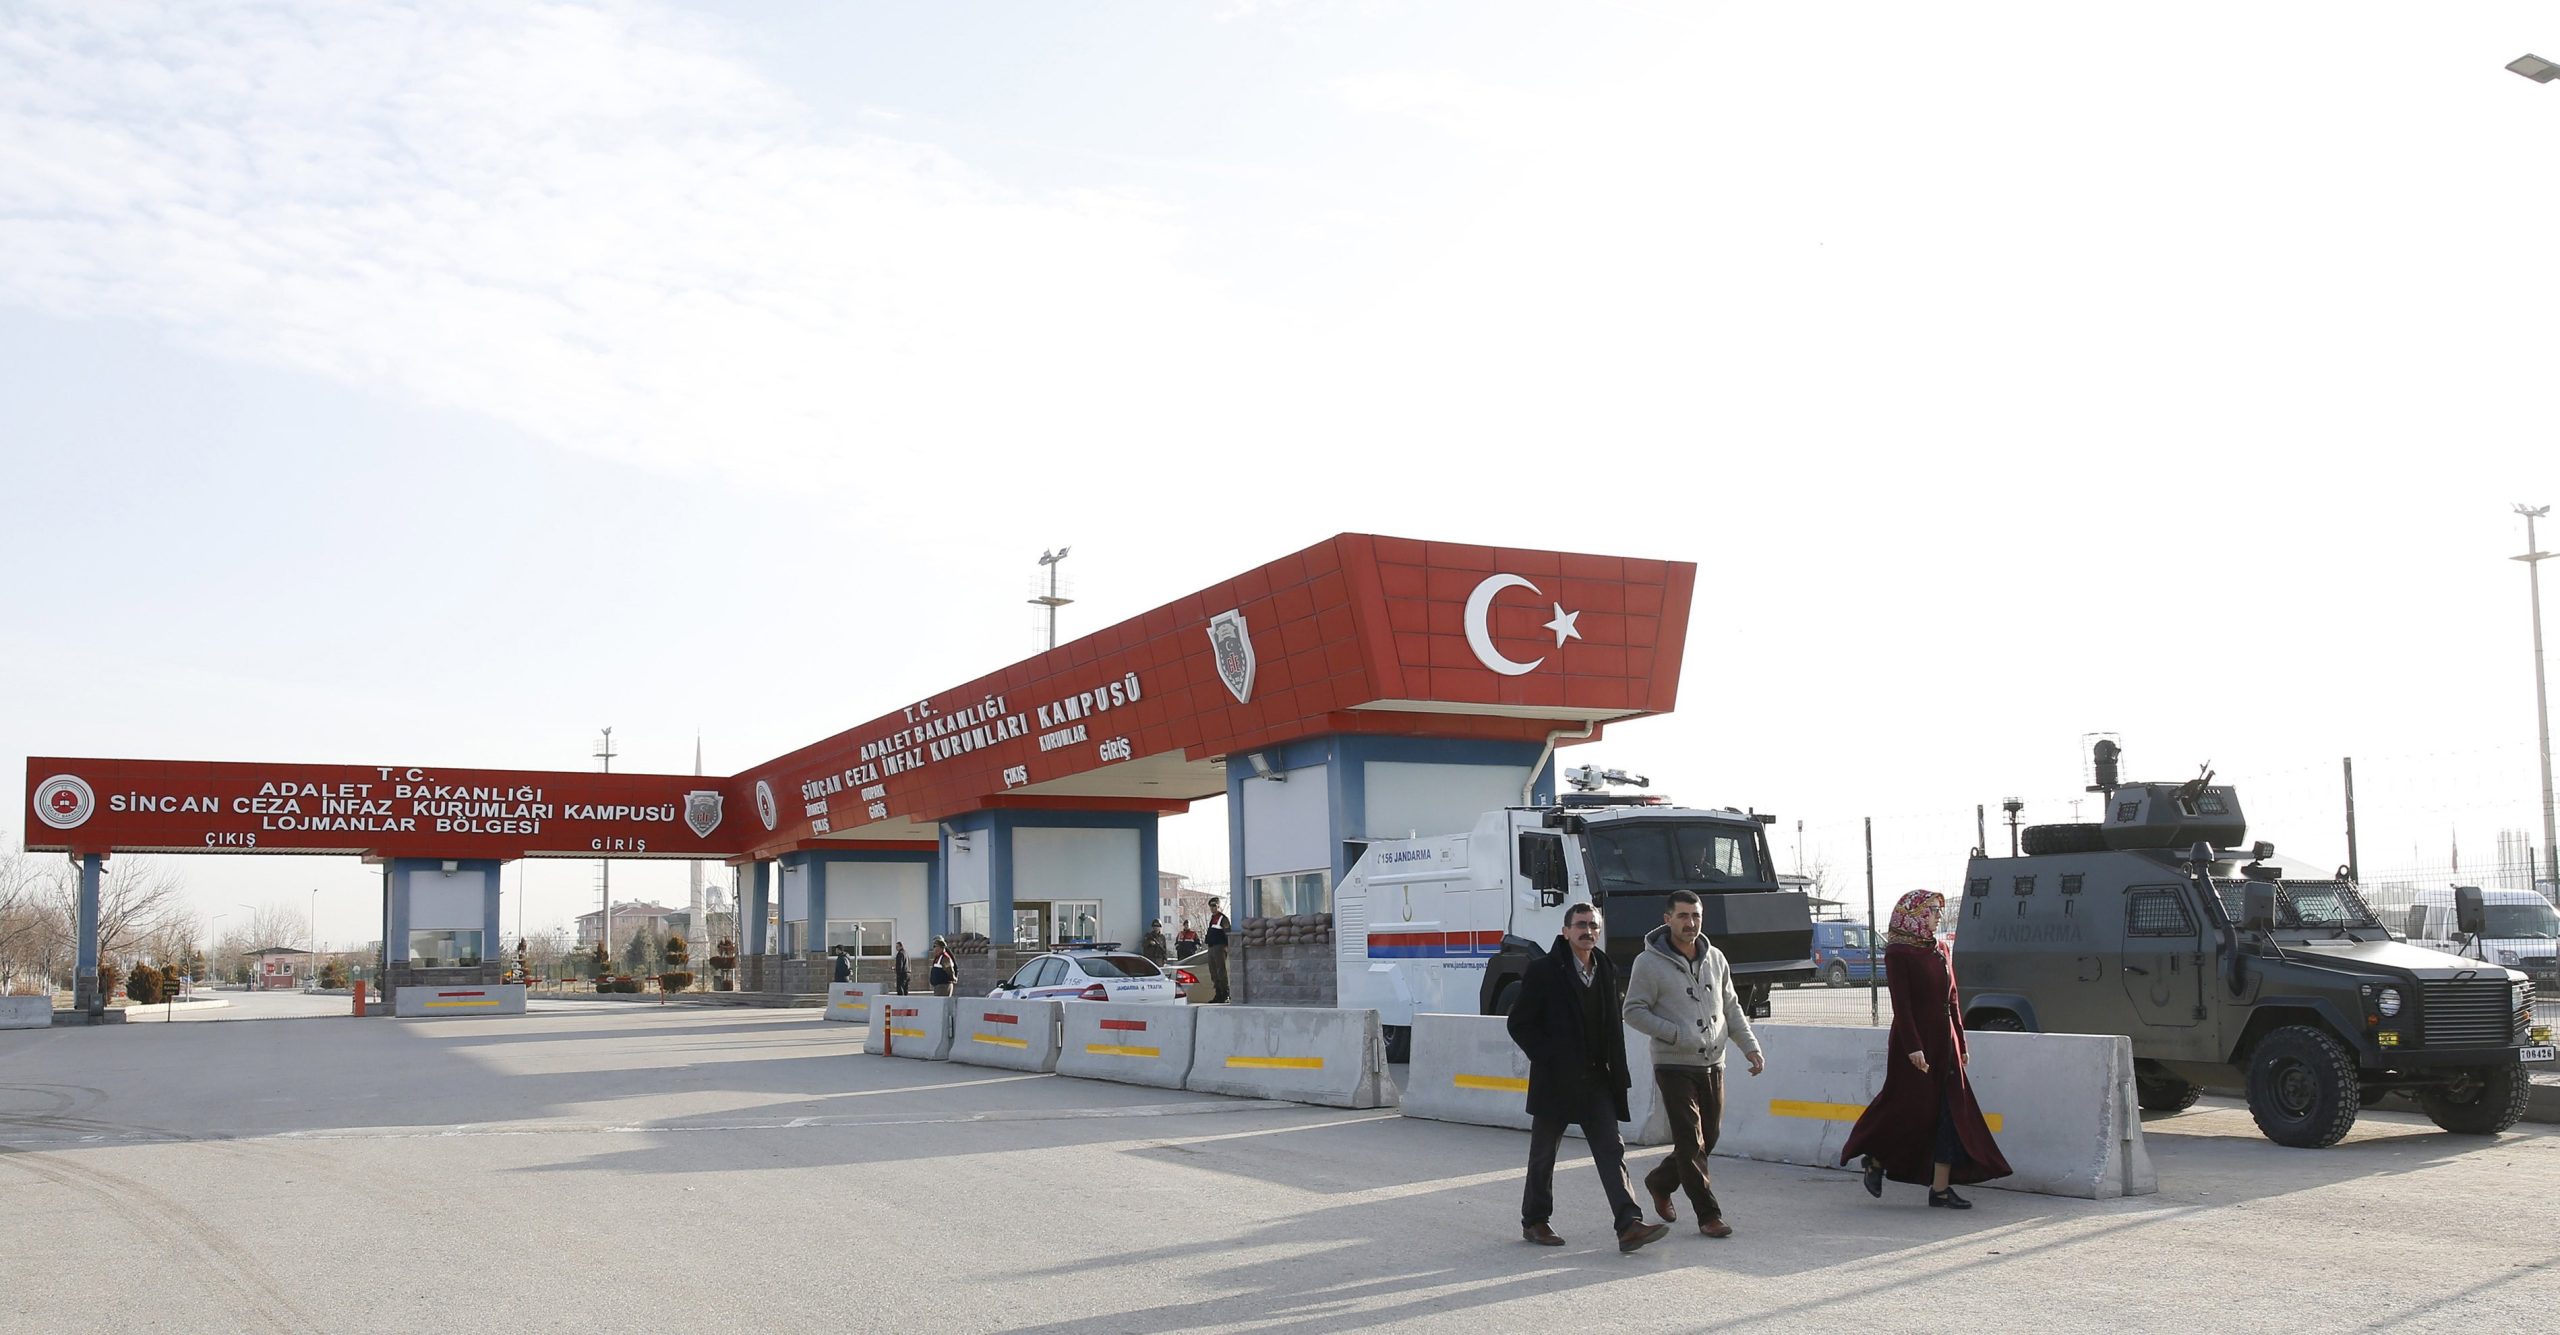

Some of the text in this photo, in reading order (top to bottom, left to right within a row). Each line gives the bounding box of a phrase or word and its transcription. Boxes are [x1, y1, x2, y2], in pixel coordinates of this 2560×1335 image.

[904, 700, 938, 724] T.C.
[845, 762, 879, 787] CEZA
[881, 747, 925, 777] İNFAZ
[929, 712, 1029, 762] KURUMLARI
[1037, 672, 1142, 730] KAMPUSÜ
[861, 694, 1007, 763] ADALET BAKANLIĞI
[1039, 725, 1088, 753] KURUMLAR
[1099, 736, 1132, 763] GİRİŞ
[376, 768, 434, 782] T.C.
[1003, 764, 1028, 790] ÇIKIŞ
[259, 782, 542, 802] ADALET BAKANLIĞI
[110, 792, 219, 813] SİNCAN
[232, 798, 301, 815] CEZA
[321, 797, 393, 816] İNFAZ
[412, 800, 553, 819] KURUMLARI
[564, 803, 675, 822] KAMPUSÜ
[262, 816, 540, 834] LOJMANLAR BÖLGESİ
[205, 832, 646, 853] ÇIKIŞ GİRİŞ
[1381, 853, 1393, 864] 156
[1394, 849, 1432, 863] JANDARMA
[1988, 923, 2084, 943] JANDARMA
